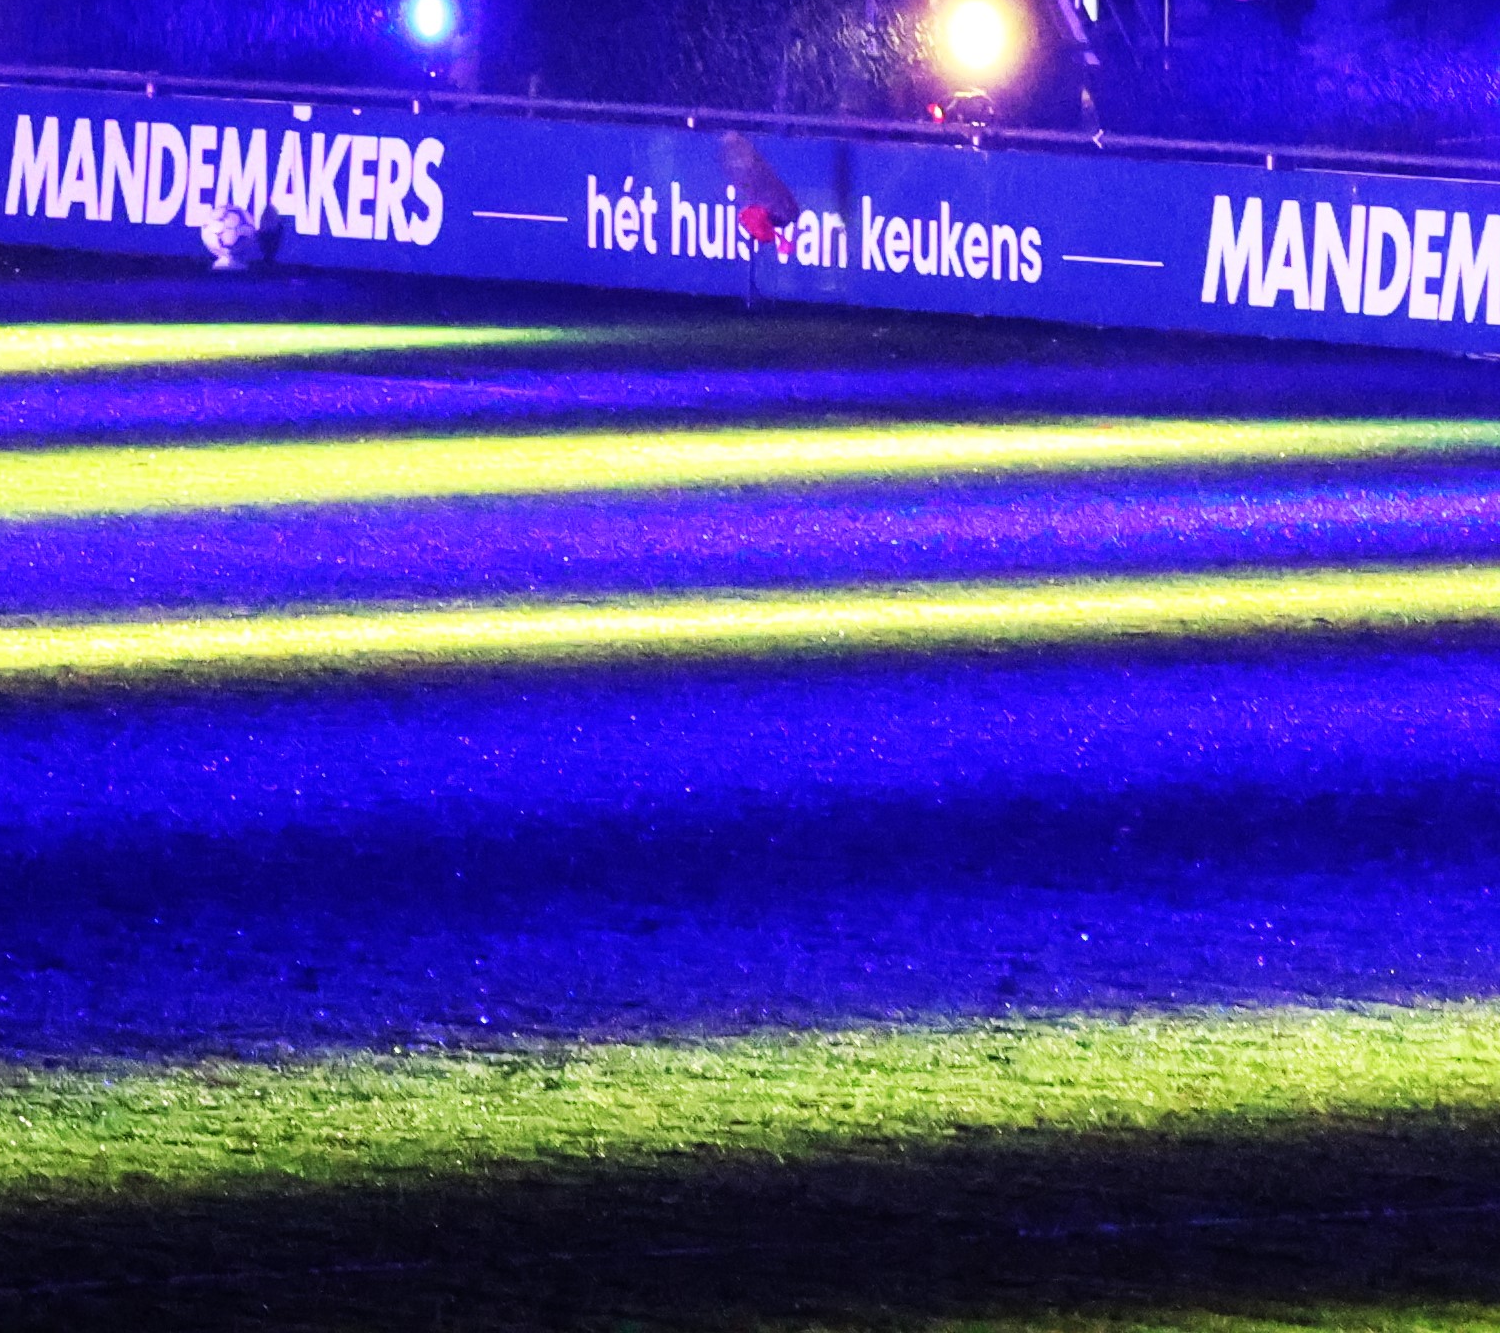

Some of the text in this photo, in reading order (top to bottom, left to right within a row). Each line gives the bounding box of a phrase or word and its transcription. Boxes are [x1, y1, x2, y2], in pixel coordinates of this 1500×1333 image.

[5, 114, 444, 245] MANDEMAKERS
[587, 174, 658, 255] hét
[861, 195, 1042, 283] keukens
